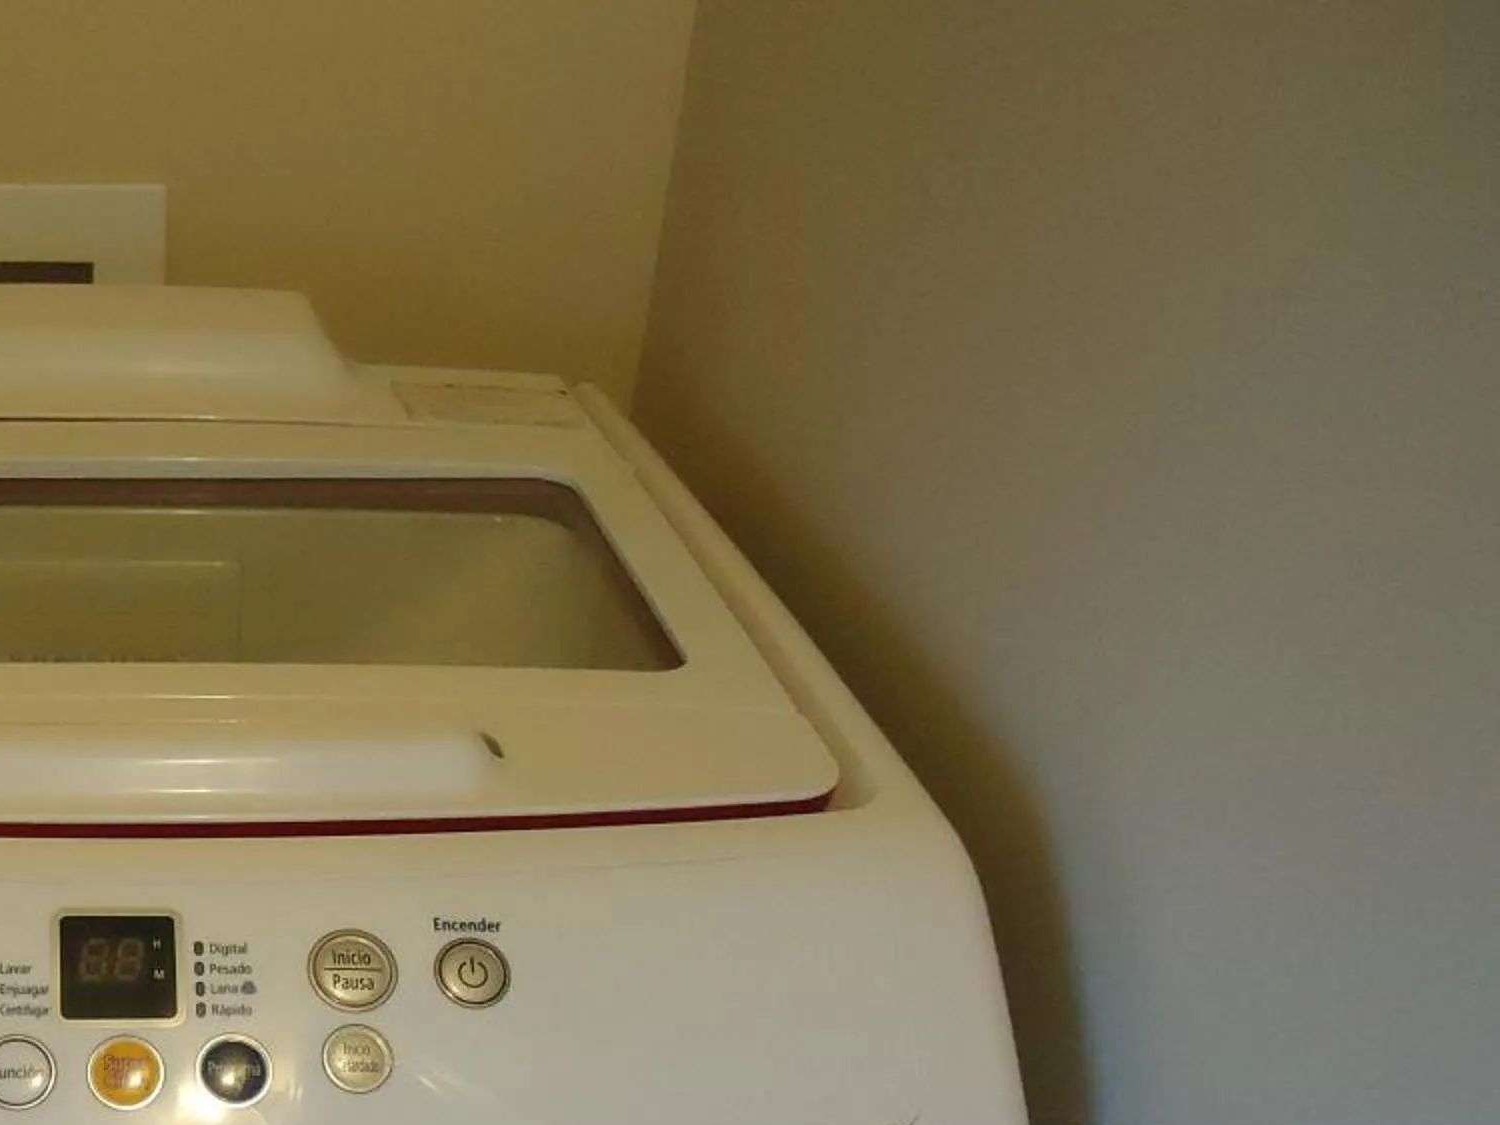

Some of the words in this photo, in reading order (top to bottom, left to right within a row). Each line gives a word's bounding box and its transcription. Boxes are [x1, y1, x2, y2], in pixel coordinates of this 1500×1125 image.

[433, 917, 501, 933] Encender
[209, 943, 248, 957] Digital
[332, 949, 372, 967] Inicio
[0, 962, 32, 975] Lavar
[209, 963, 252, 975] Pesado
[210, 983, 238, 994] Lana
[333, 974, 375, 991] Pausa
[0, 983, 50, 999] Enjuagar
